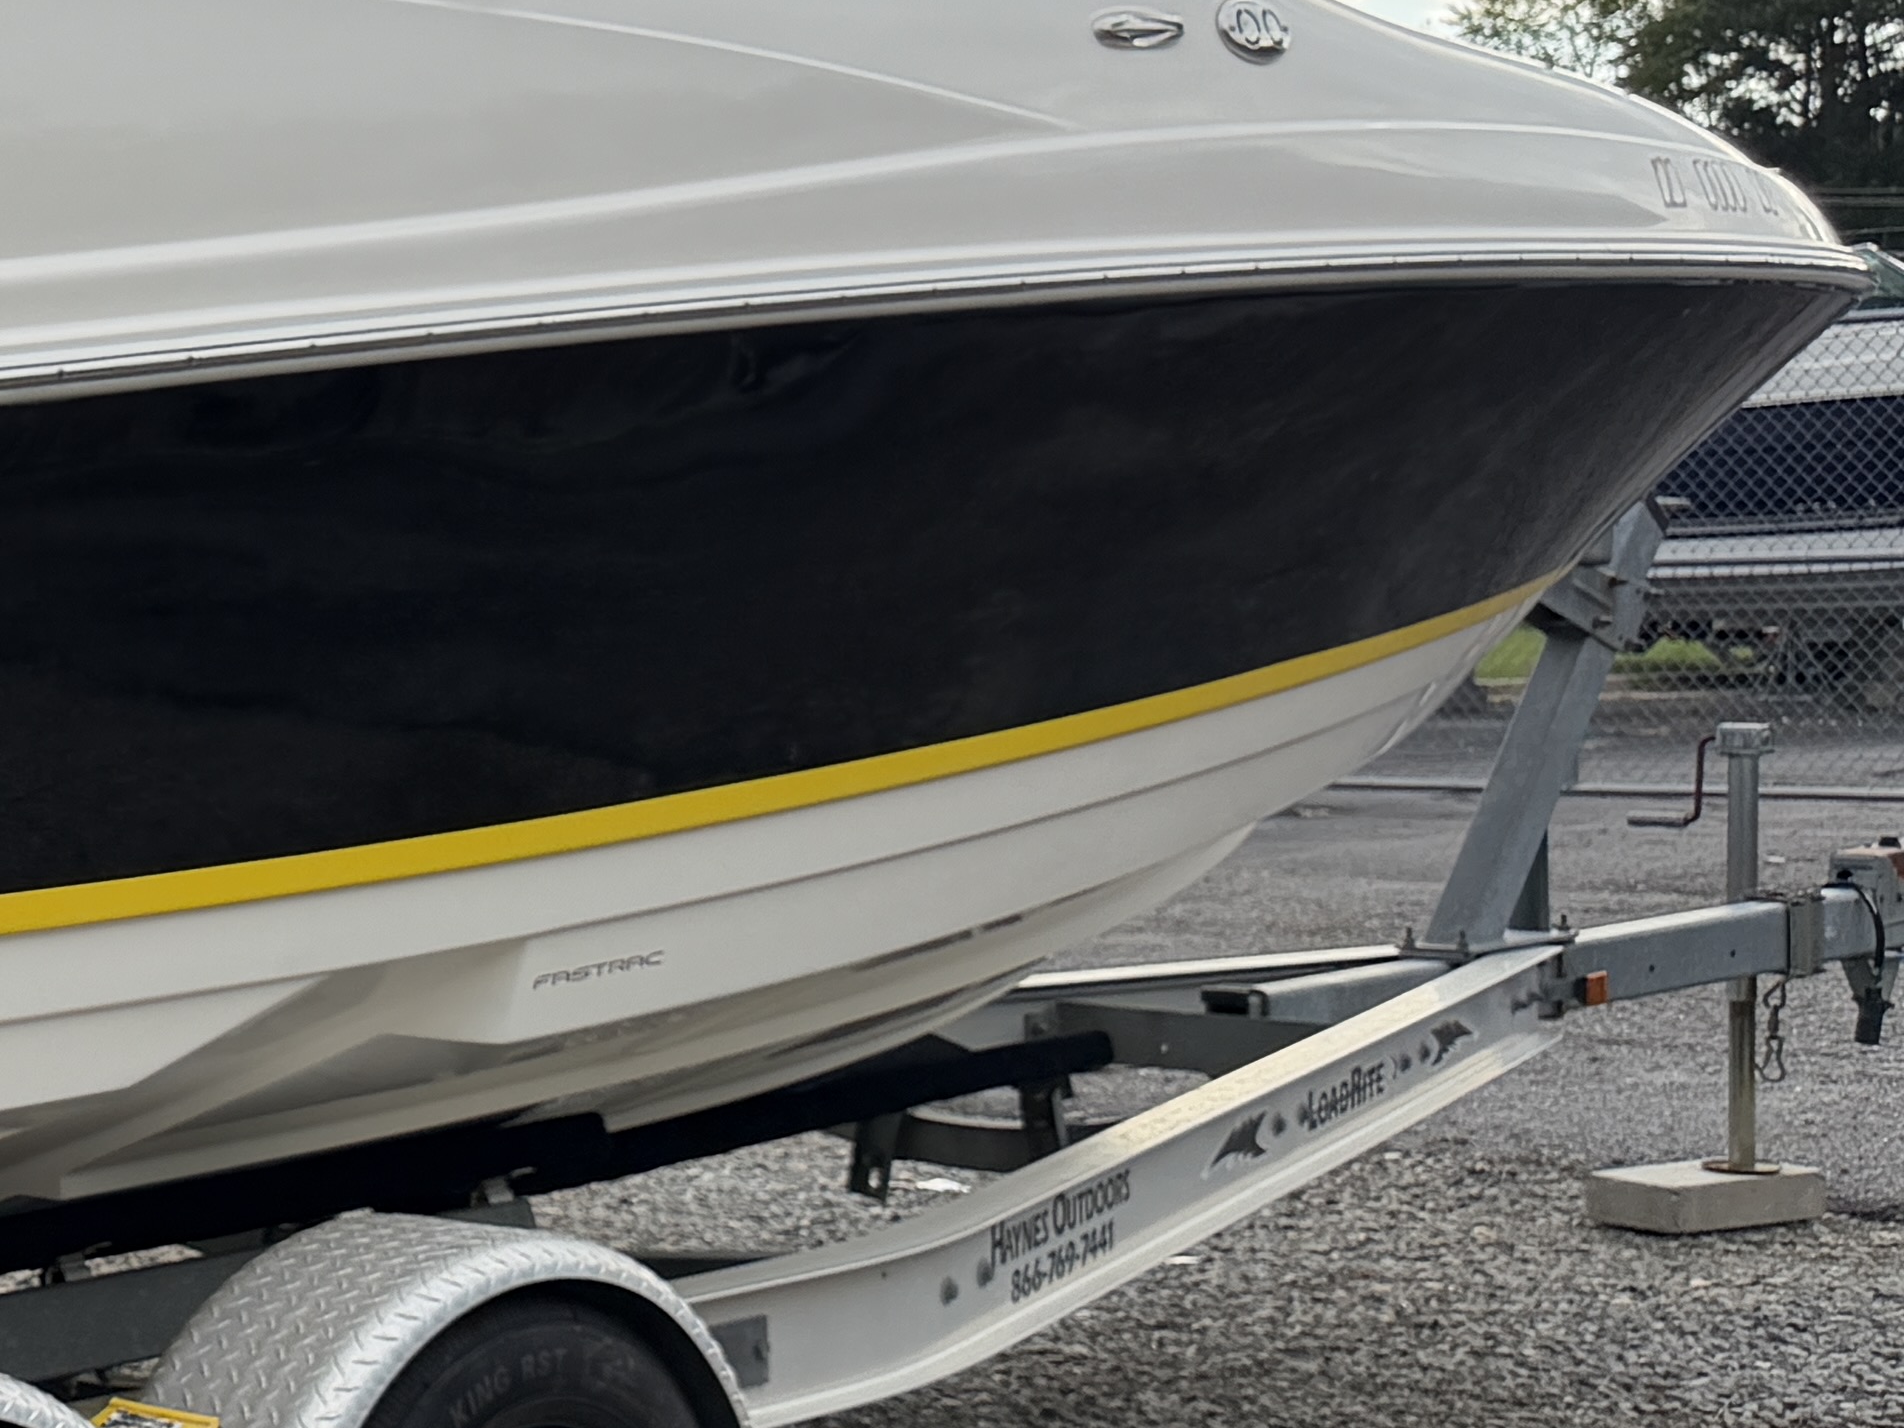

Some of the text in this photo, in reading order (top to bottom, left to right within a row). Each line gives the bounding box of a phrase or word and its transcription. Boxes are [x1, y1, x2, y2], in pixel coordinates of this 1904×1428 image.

[532, 949, 665, 990] FASTRAC
[990, 1168, 1131, 1274] HAYNES OUTDOORS
[448, 1365, 513, 1428] KING
[520, 1347, 568, 1378] RST
